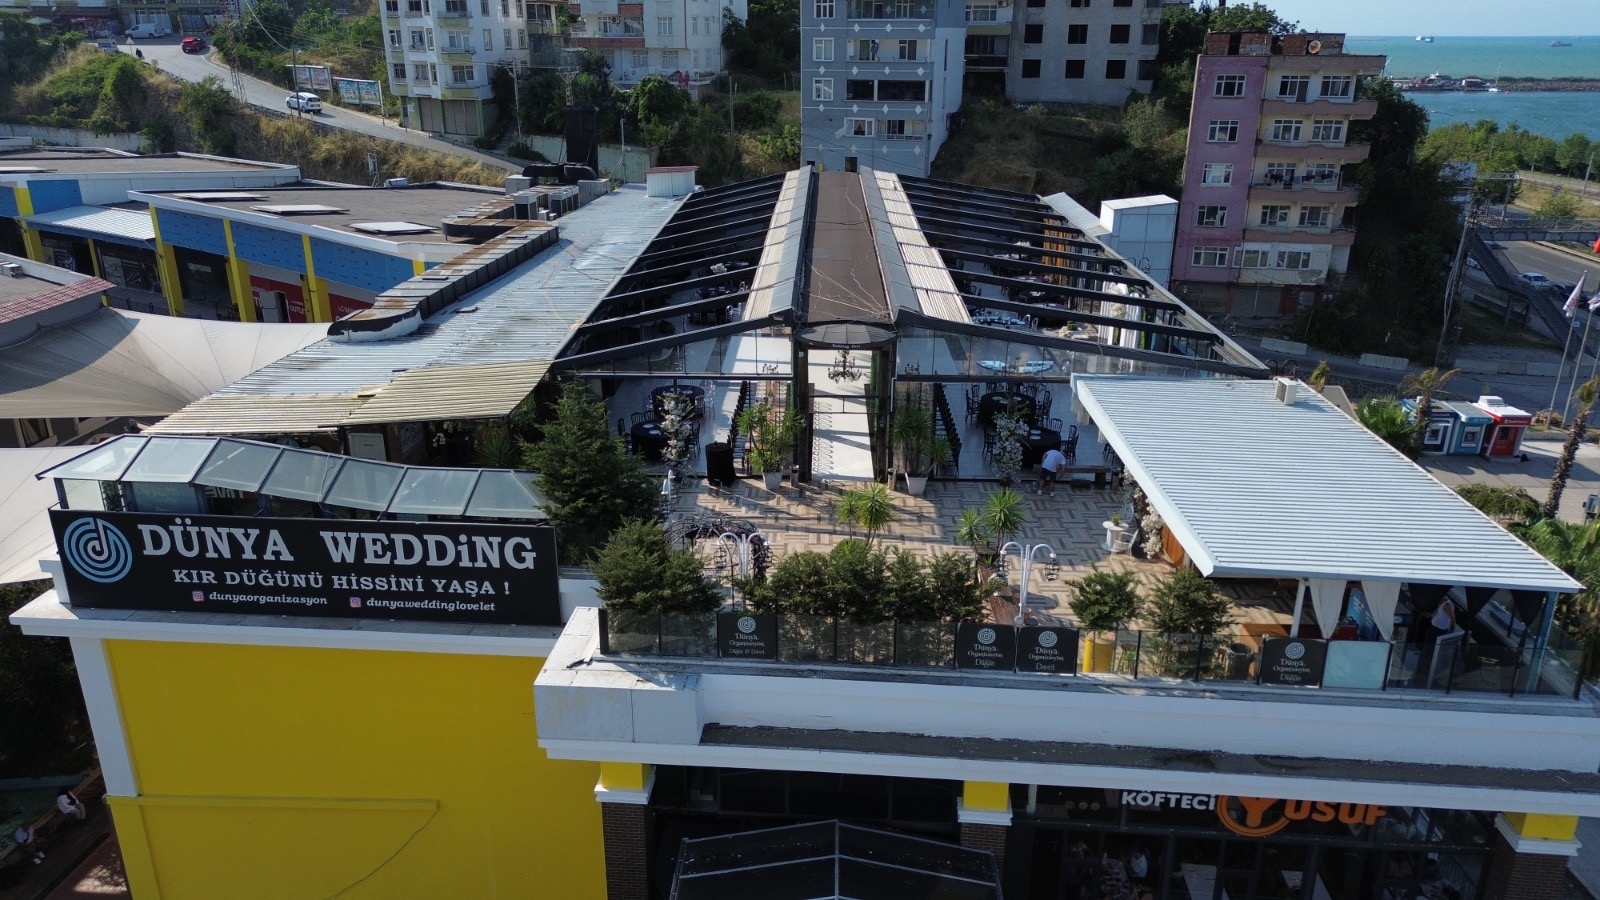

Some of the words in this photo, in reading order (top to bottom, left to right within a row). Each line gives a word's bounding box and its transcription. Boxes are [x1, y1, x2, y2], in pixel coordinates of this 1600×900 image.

[138, 517, 294, 562] DÜNYA
[173, 569, 217, 584] KIR
[224, 569, 323, 588] DÜĞÜNÜ
[332, 573, 424, 592] HİSSİNİ
[432, 579, 495, 597] YAŞA
[504, 581, 510, 595] !
[209, 591, 328, 606] dunyaorganizasyon
[366, 597, 495, 611] dunyaweddinglovelet
[735, 633, 759, 641] Dünya
[1034, 647, 1058, 655] Dünya
[1280, 658, 1304, 667] Dünya
